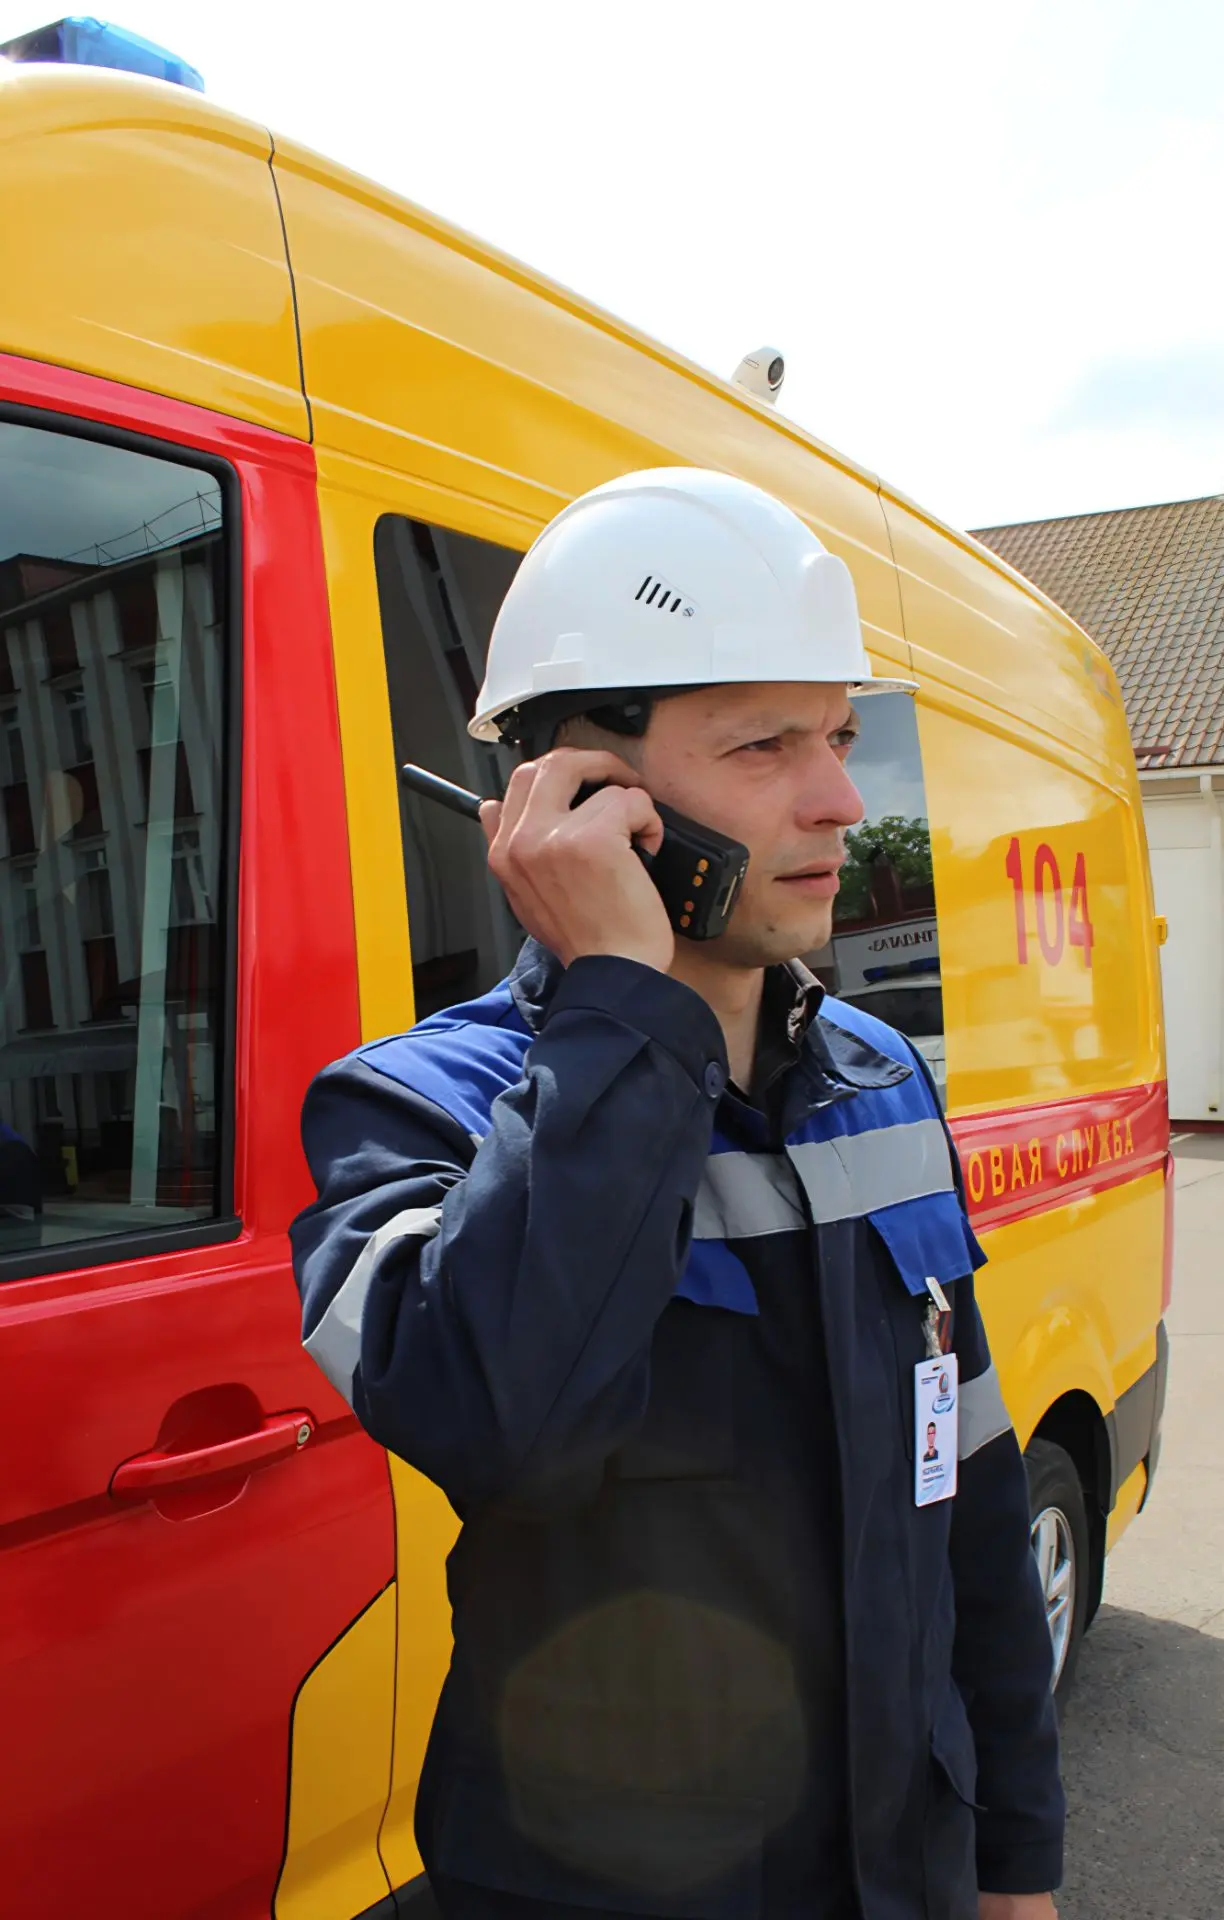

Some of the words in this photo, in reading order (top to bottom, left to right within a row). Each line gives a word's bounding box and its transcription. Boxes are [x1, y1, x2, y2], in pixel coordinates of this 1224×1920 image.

[1006, 838, 1094, 968] 104
[968, 1138, 1043, 1203] ОВАЯ
[1057, 1119, 1134, 1177] СЛУЖБА
